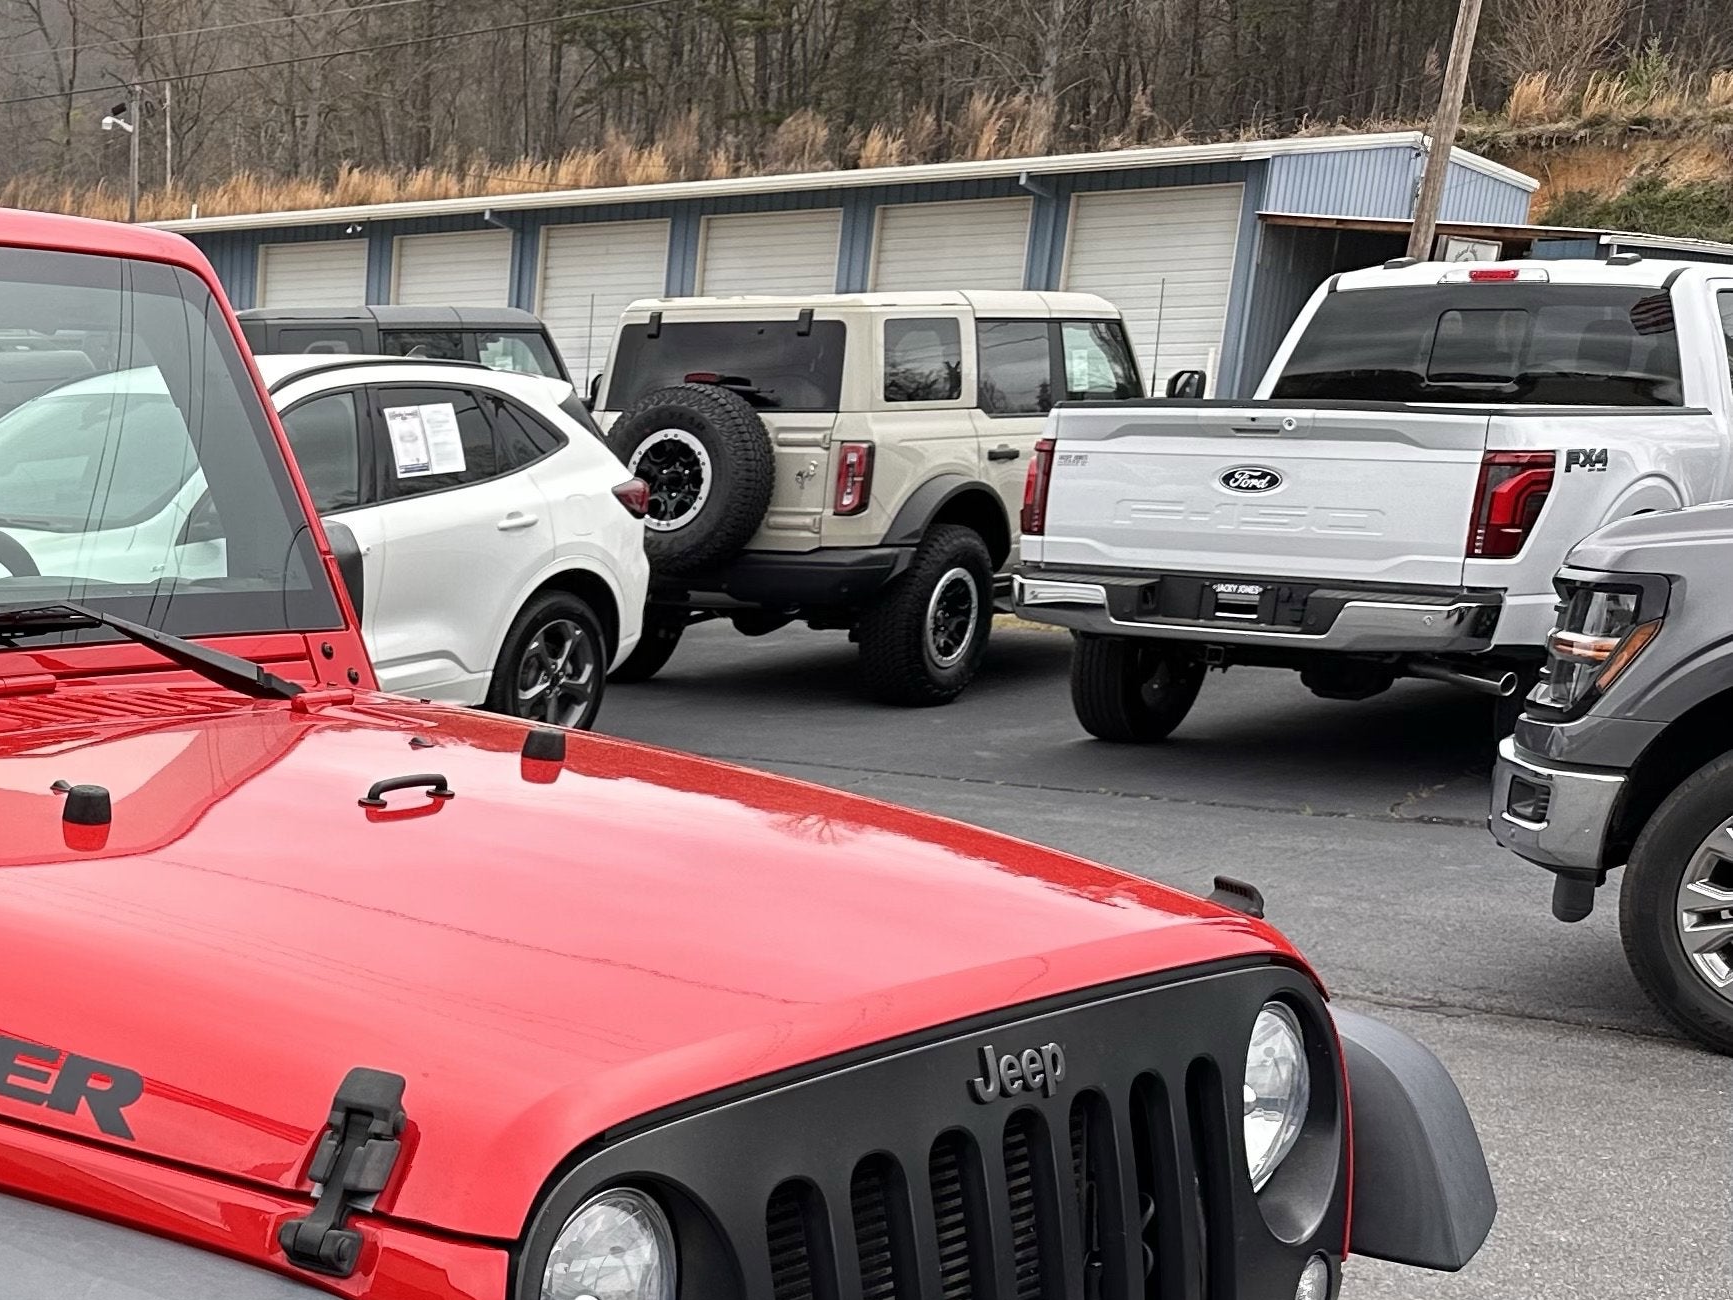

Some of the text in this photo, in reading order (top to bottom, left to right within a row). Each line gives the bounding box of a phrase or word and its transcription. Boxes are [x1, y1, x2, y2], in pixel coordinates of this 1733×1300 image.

[1564, 448, 1608, 473] FX4
[1229, 469, 1269, 490] Ford
[1113, 498, 1387, 536] F-150
[1215, 583, 1260, 595] JACKY JONES
[968, 1041, 1066, 1104] Jeep
